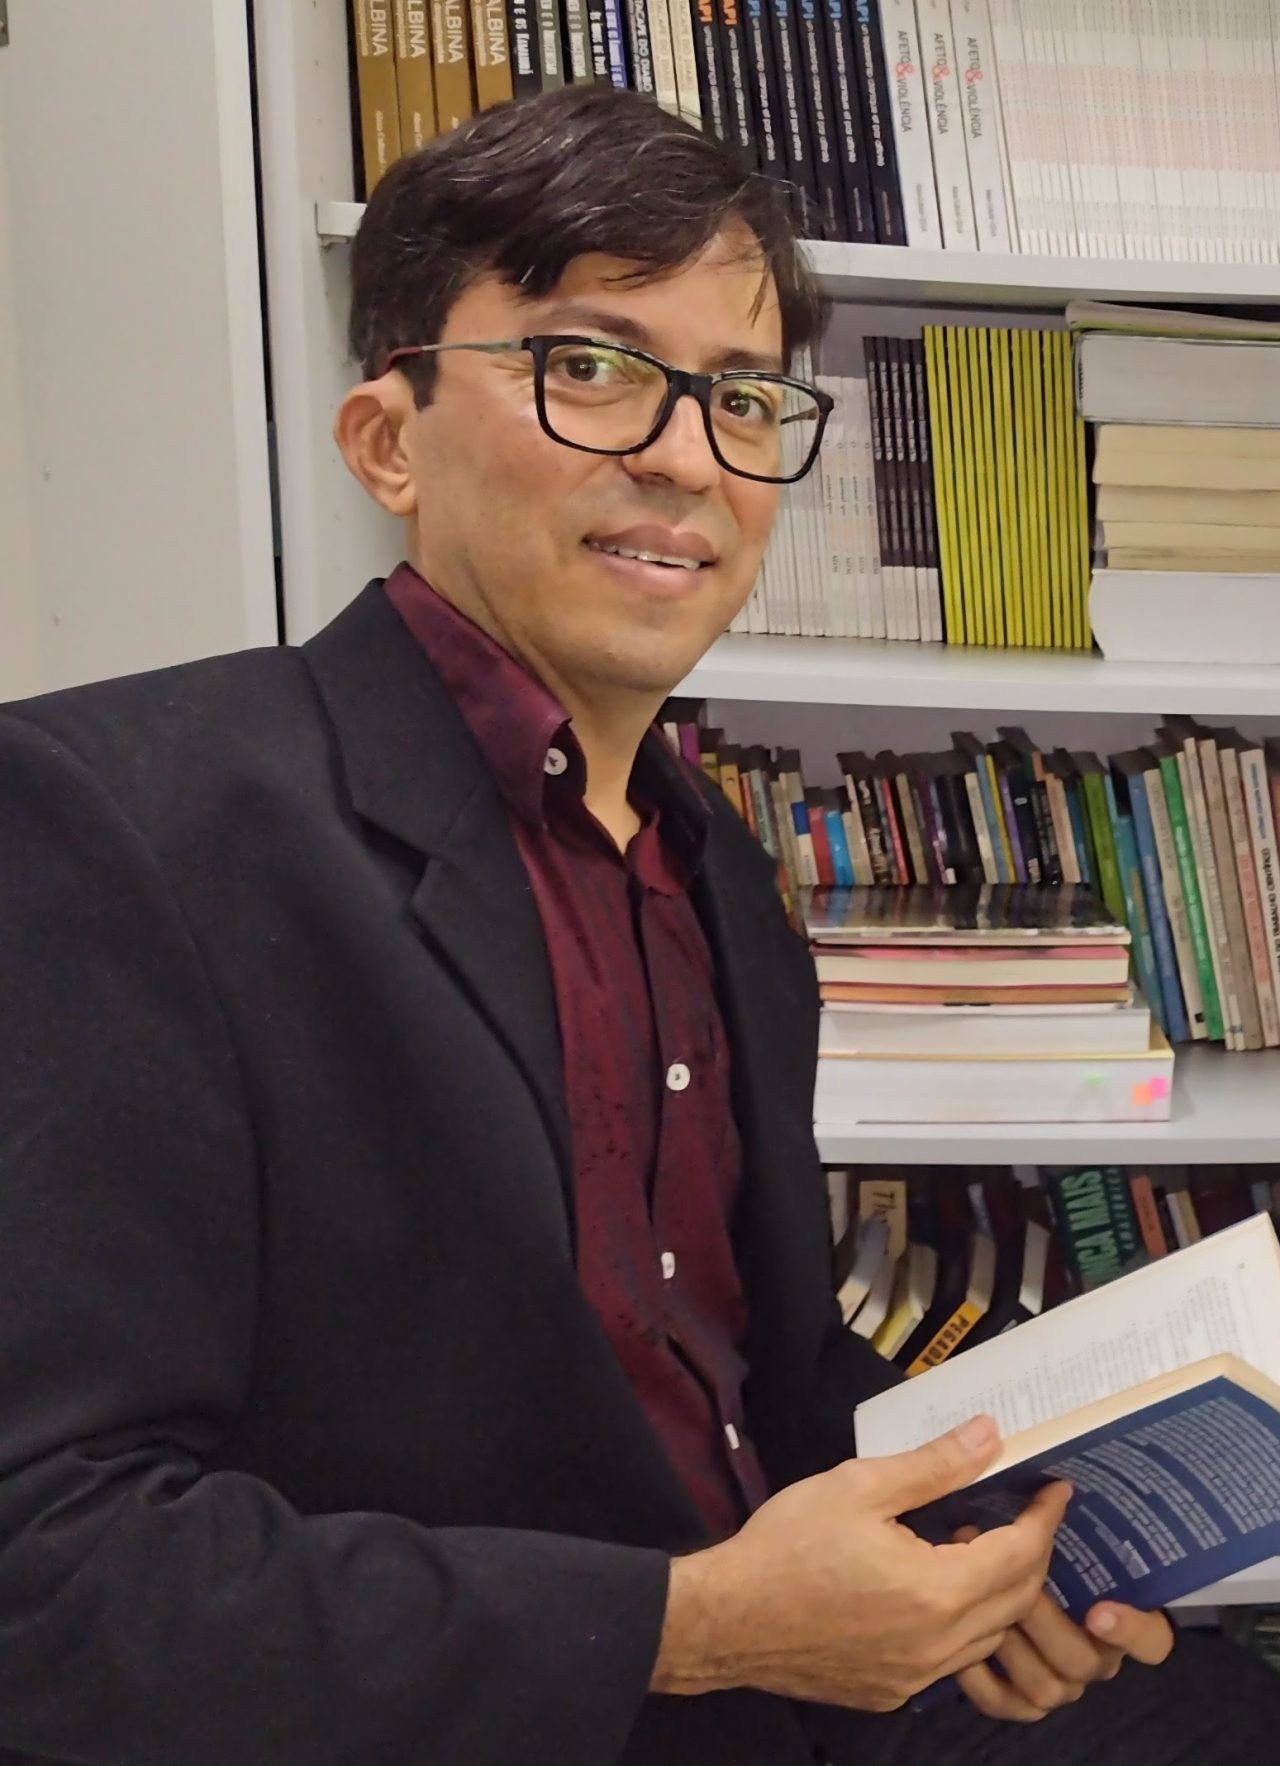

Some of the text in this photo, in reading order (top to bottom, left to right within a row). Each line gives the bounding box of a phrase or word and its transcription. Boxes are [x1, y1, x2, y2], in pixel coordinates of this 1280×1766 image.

[407, 0, 426, 58] LBINA
[445, 0, 465, 63] LBINA
[638, 38, 649, 57] DO
[1060, 1171, 1110, 1231] MAIS
[1074, 1230, 1120, 1283] NCA
